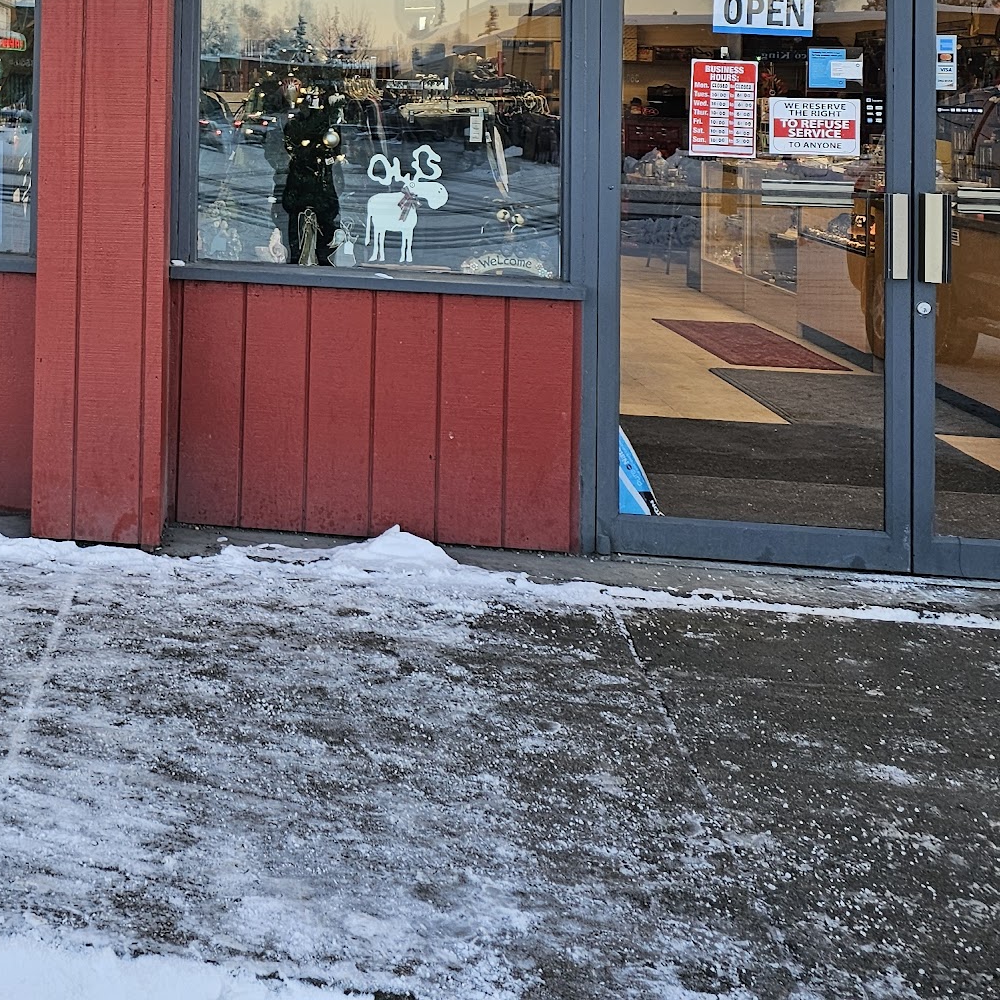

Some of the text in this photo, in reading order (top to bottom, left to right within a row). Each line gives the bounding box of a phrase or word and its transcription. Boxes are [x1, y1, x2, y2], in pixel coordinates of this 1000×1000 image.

[705, 65, 744, 74] BUSINESS
[710, 73, 740, 81] HOURS:
[789, 109, 808, 117] THE
[780, 119, 850, 129] TO REFUSE
[788, 128, 841, 138] SERVICE
